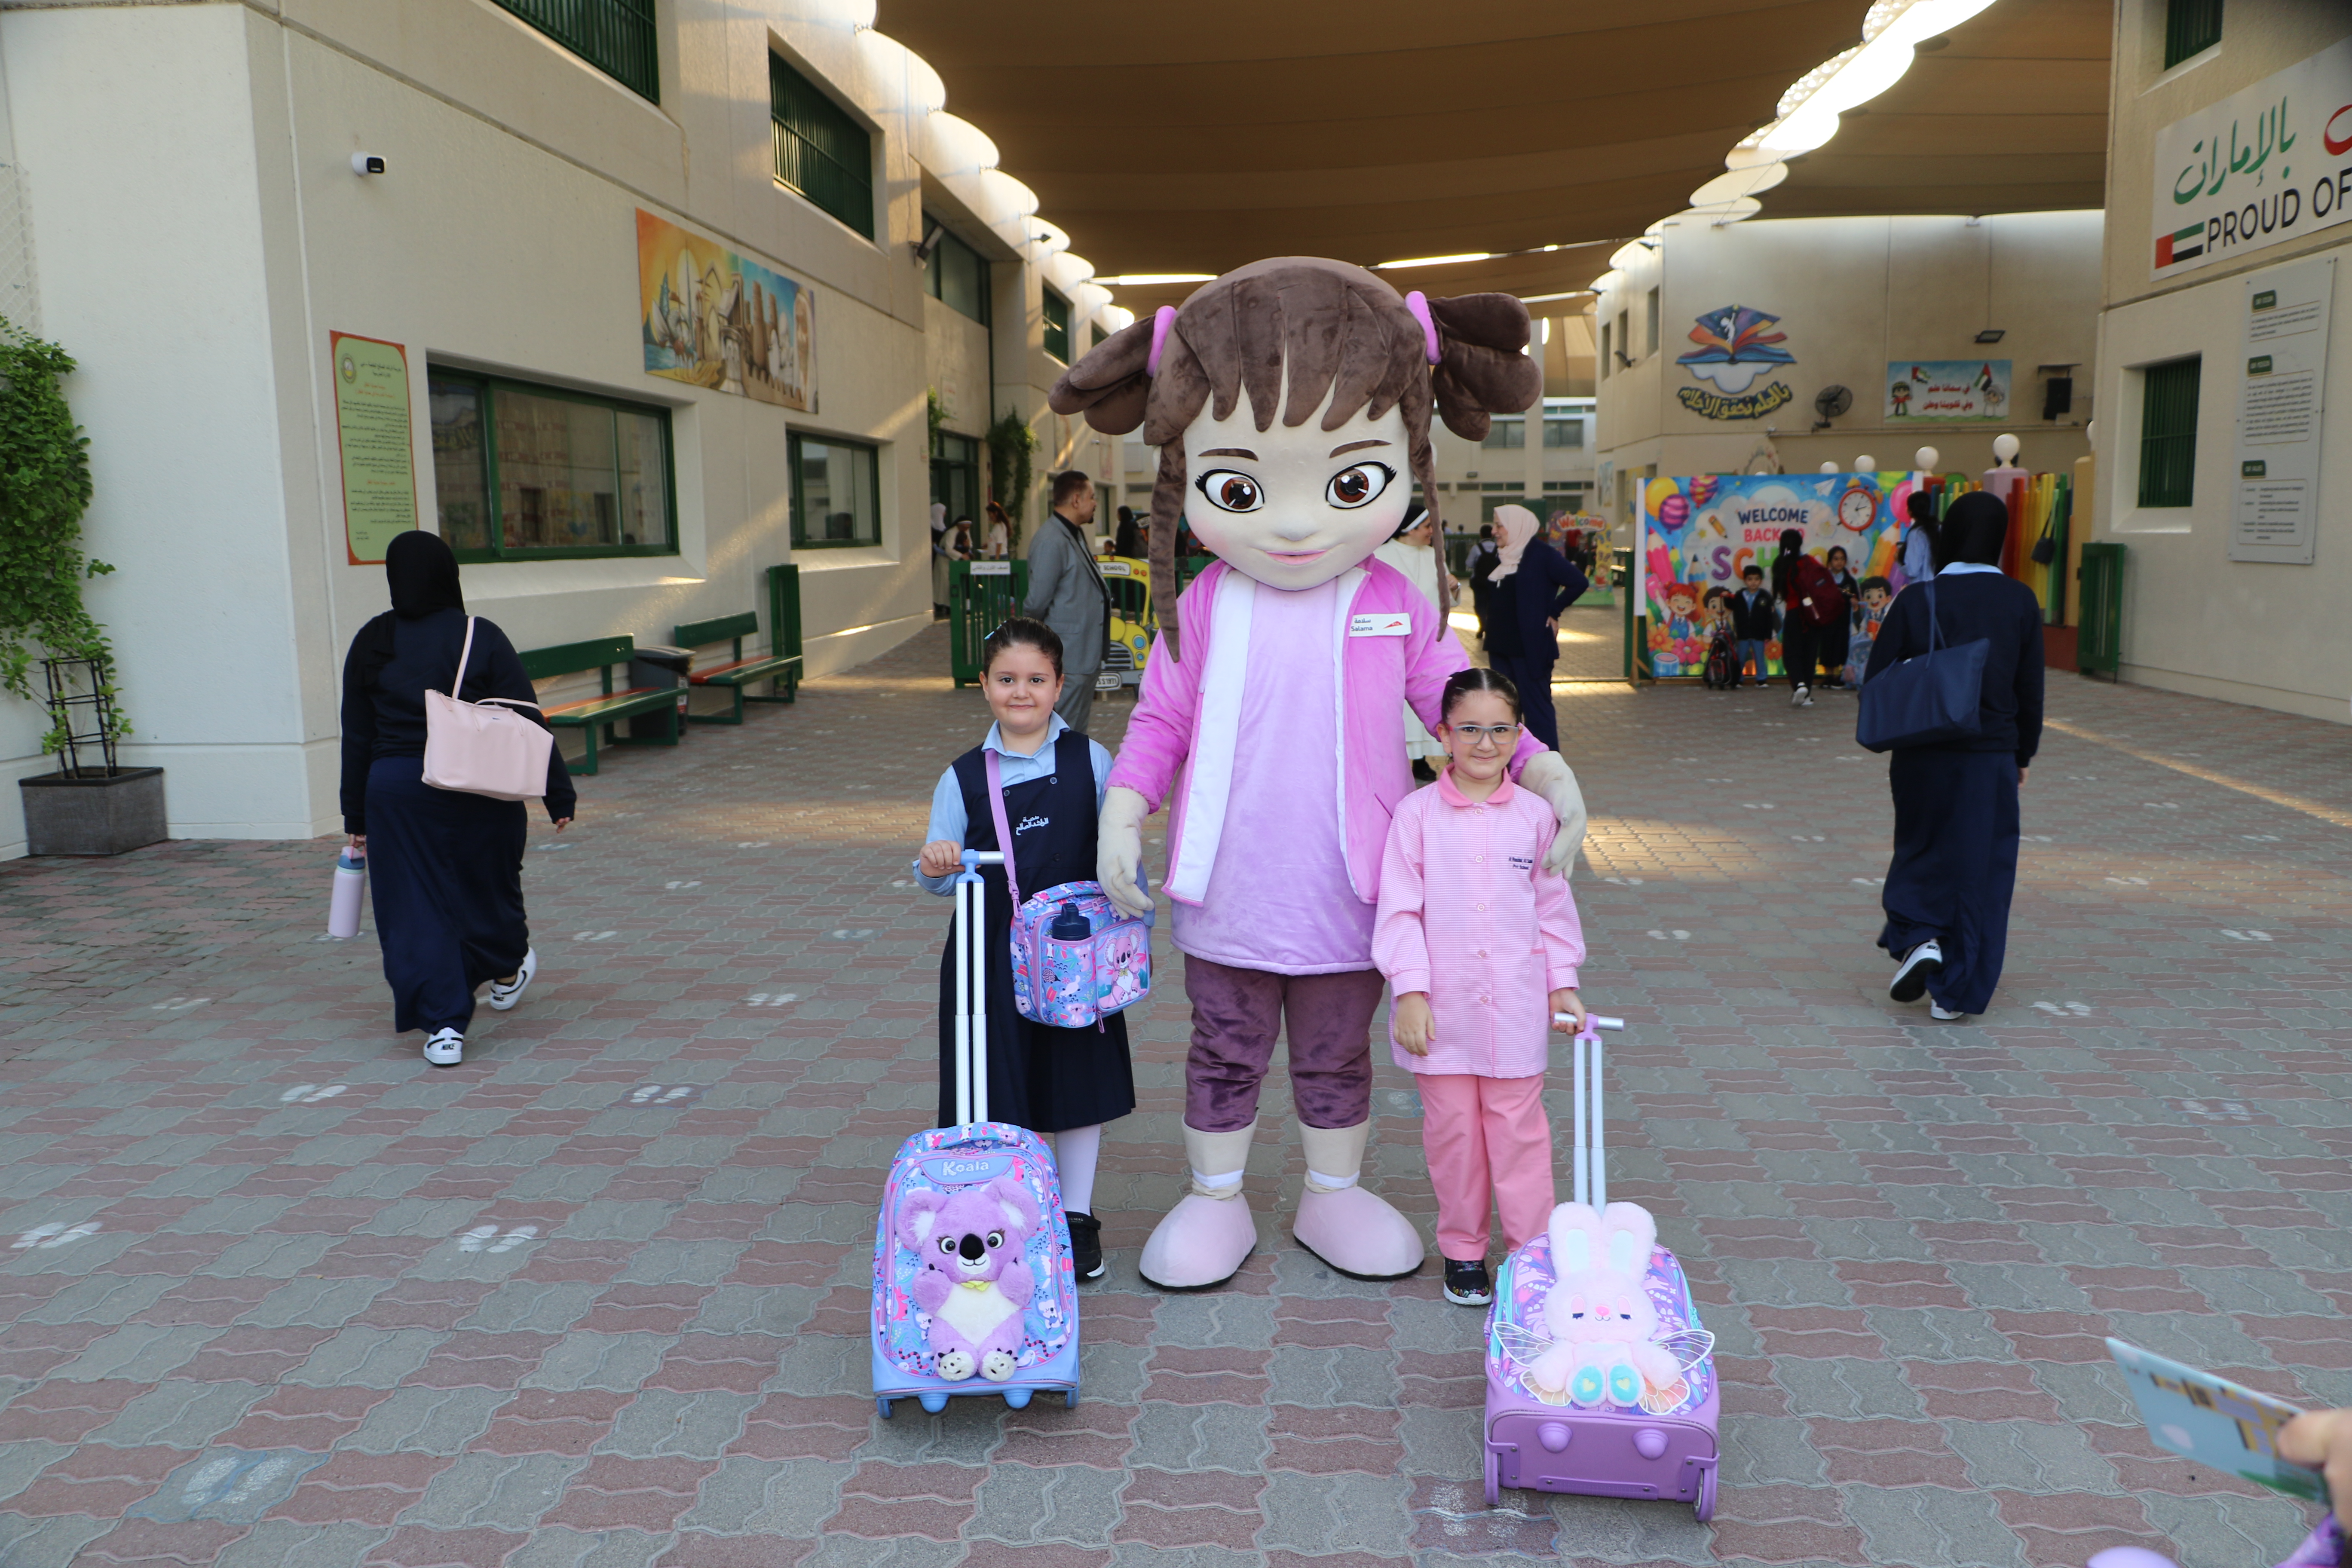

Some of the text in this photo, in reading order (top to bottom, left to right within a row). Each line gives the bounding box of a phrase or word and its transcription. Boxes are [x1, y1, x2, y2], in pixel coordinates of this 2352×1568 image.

[2207, 168, 2352, 254] PROUD OF
[1558, 516, 1604, 529] Welcome
[1738, 507, 1809, 525] WELCOME
[1744, 527, 1782, 542] BACK
[943, 1161, 989, 1176] Koala
